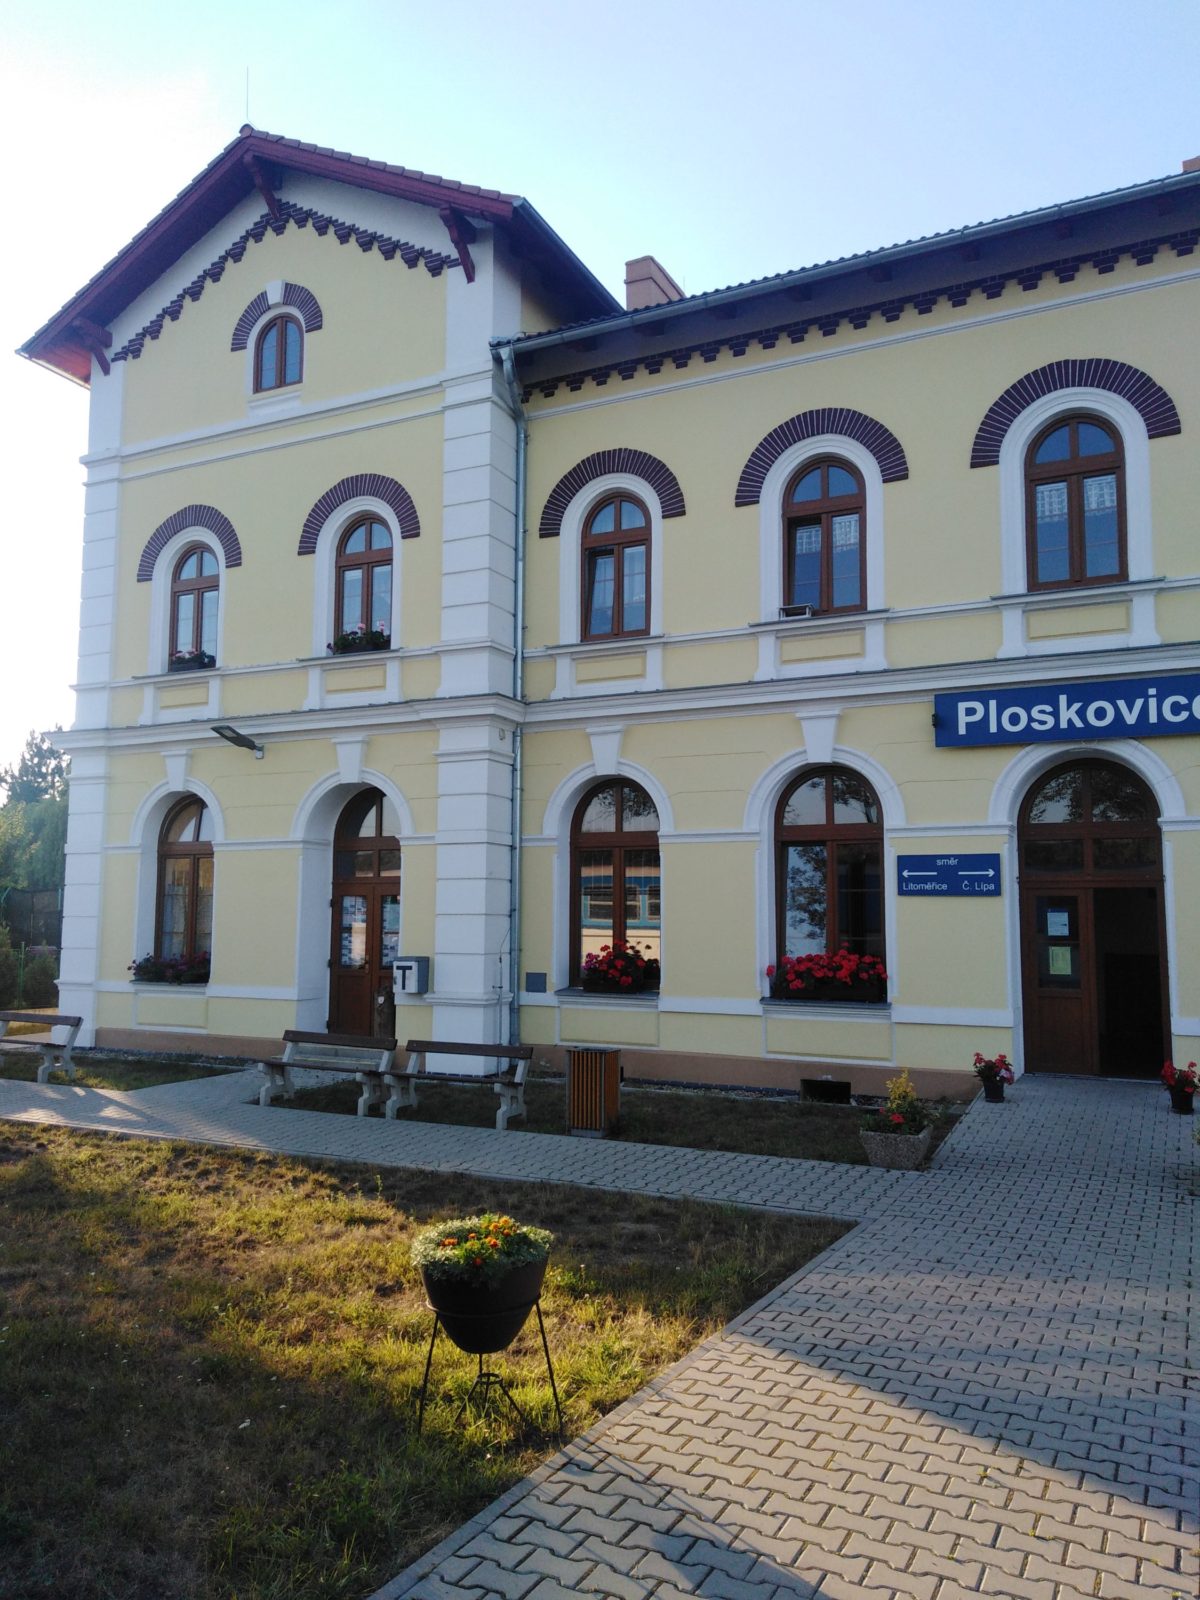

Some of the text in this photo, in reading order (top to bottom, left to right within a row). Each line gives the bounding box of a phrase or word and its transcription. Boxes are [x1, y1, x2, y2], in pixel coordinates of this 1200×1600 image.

[957, 688, 1200, 735] Ploskovic
[936, 857, 959, 866] směr
[902, 881, 948, 891] Litoměřice
[962, 880, 972, 891] Č.
[396, 965, 413, 990] T
